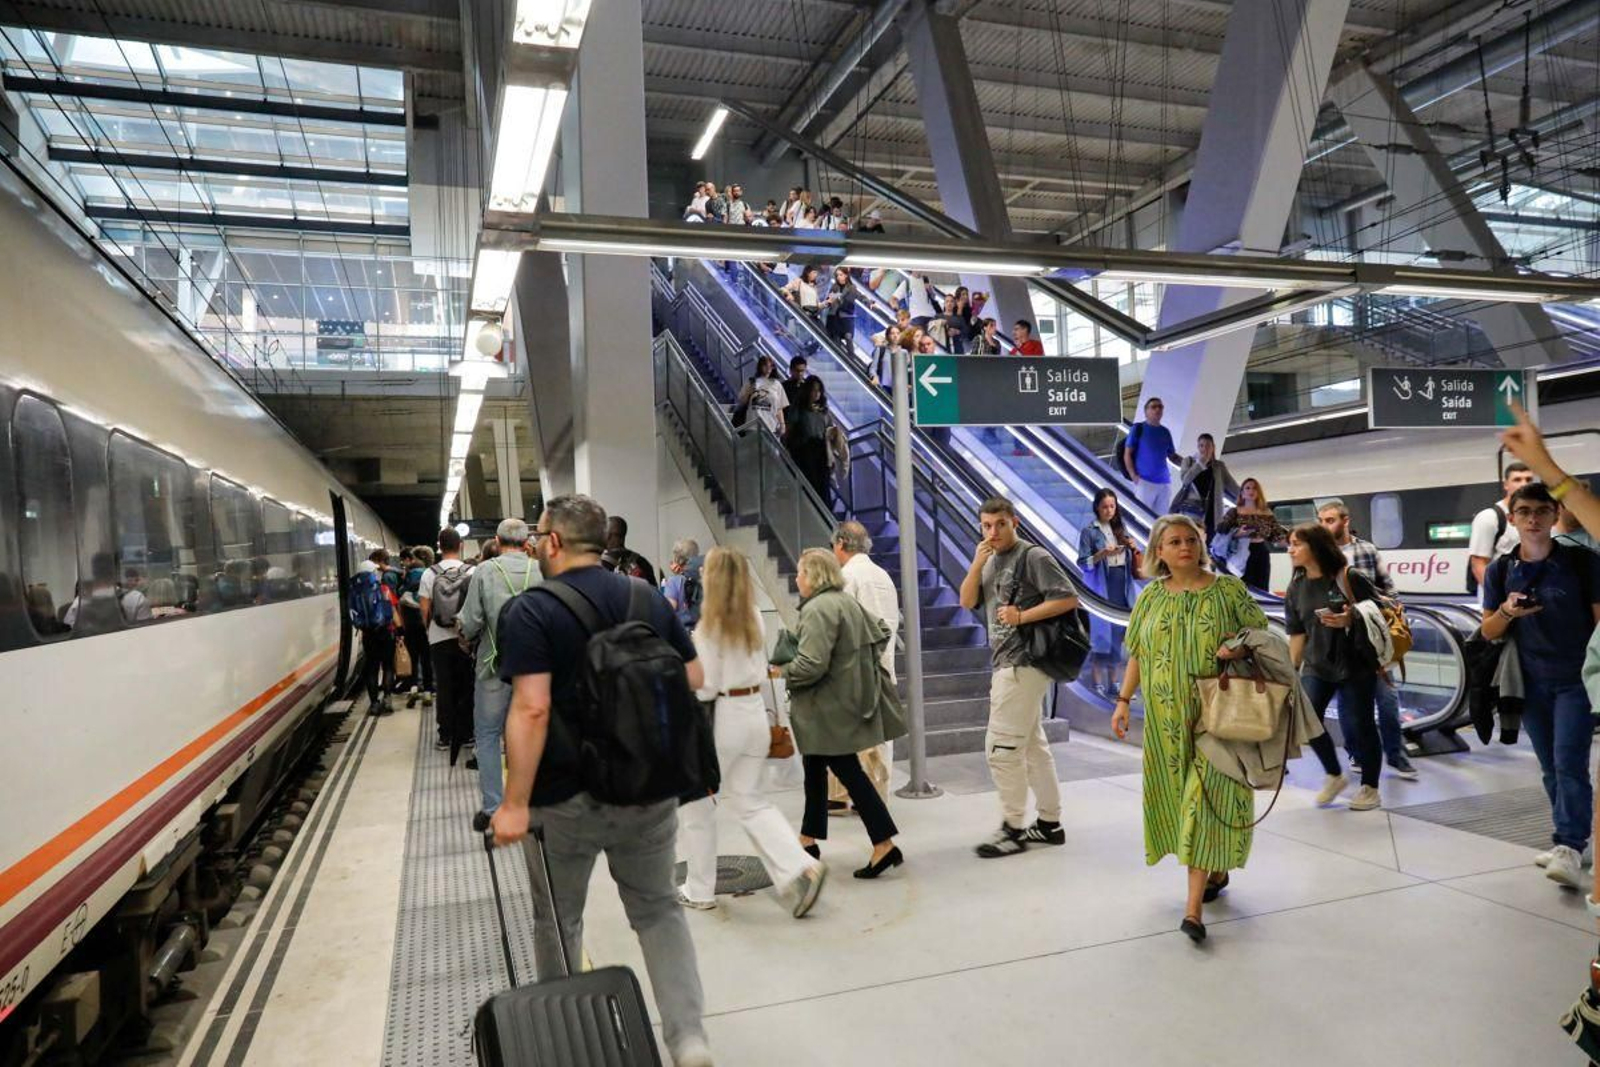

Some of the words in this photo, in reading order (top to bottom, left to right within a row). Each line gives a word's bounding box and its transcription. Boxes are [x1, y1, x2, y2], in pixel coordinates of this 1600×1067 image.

[1047, 369, 1089, 382] Salida
[1441, 379, 1474, 391] Salida
[1048, 388, 1087, 402] Saída
[1442, 395, 1472, 408] Saída
[1048, 407, 1067, 416] EXIT
[1386, 553, 1450, 583] renfe
